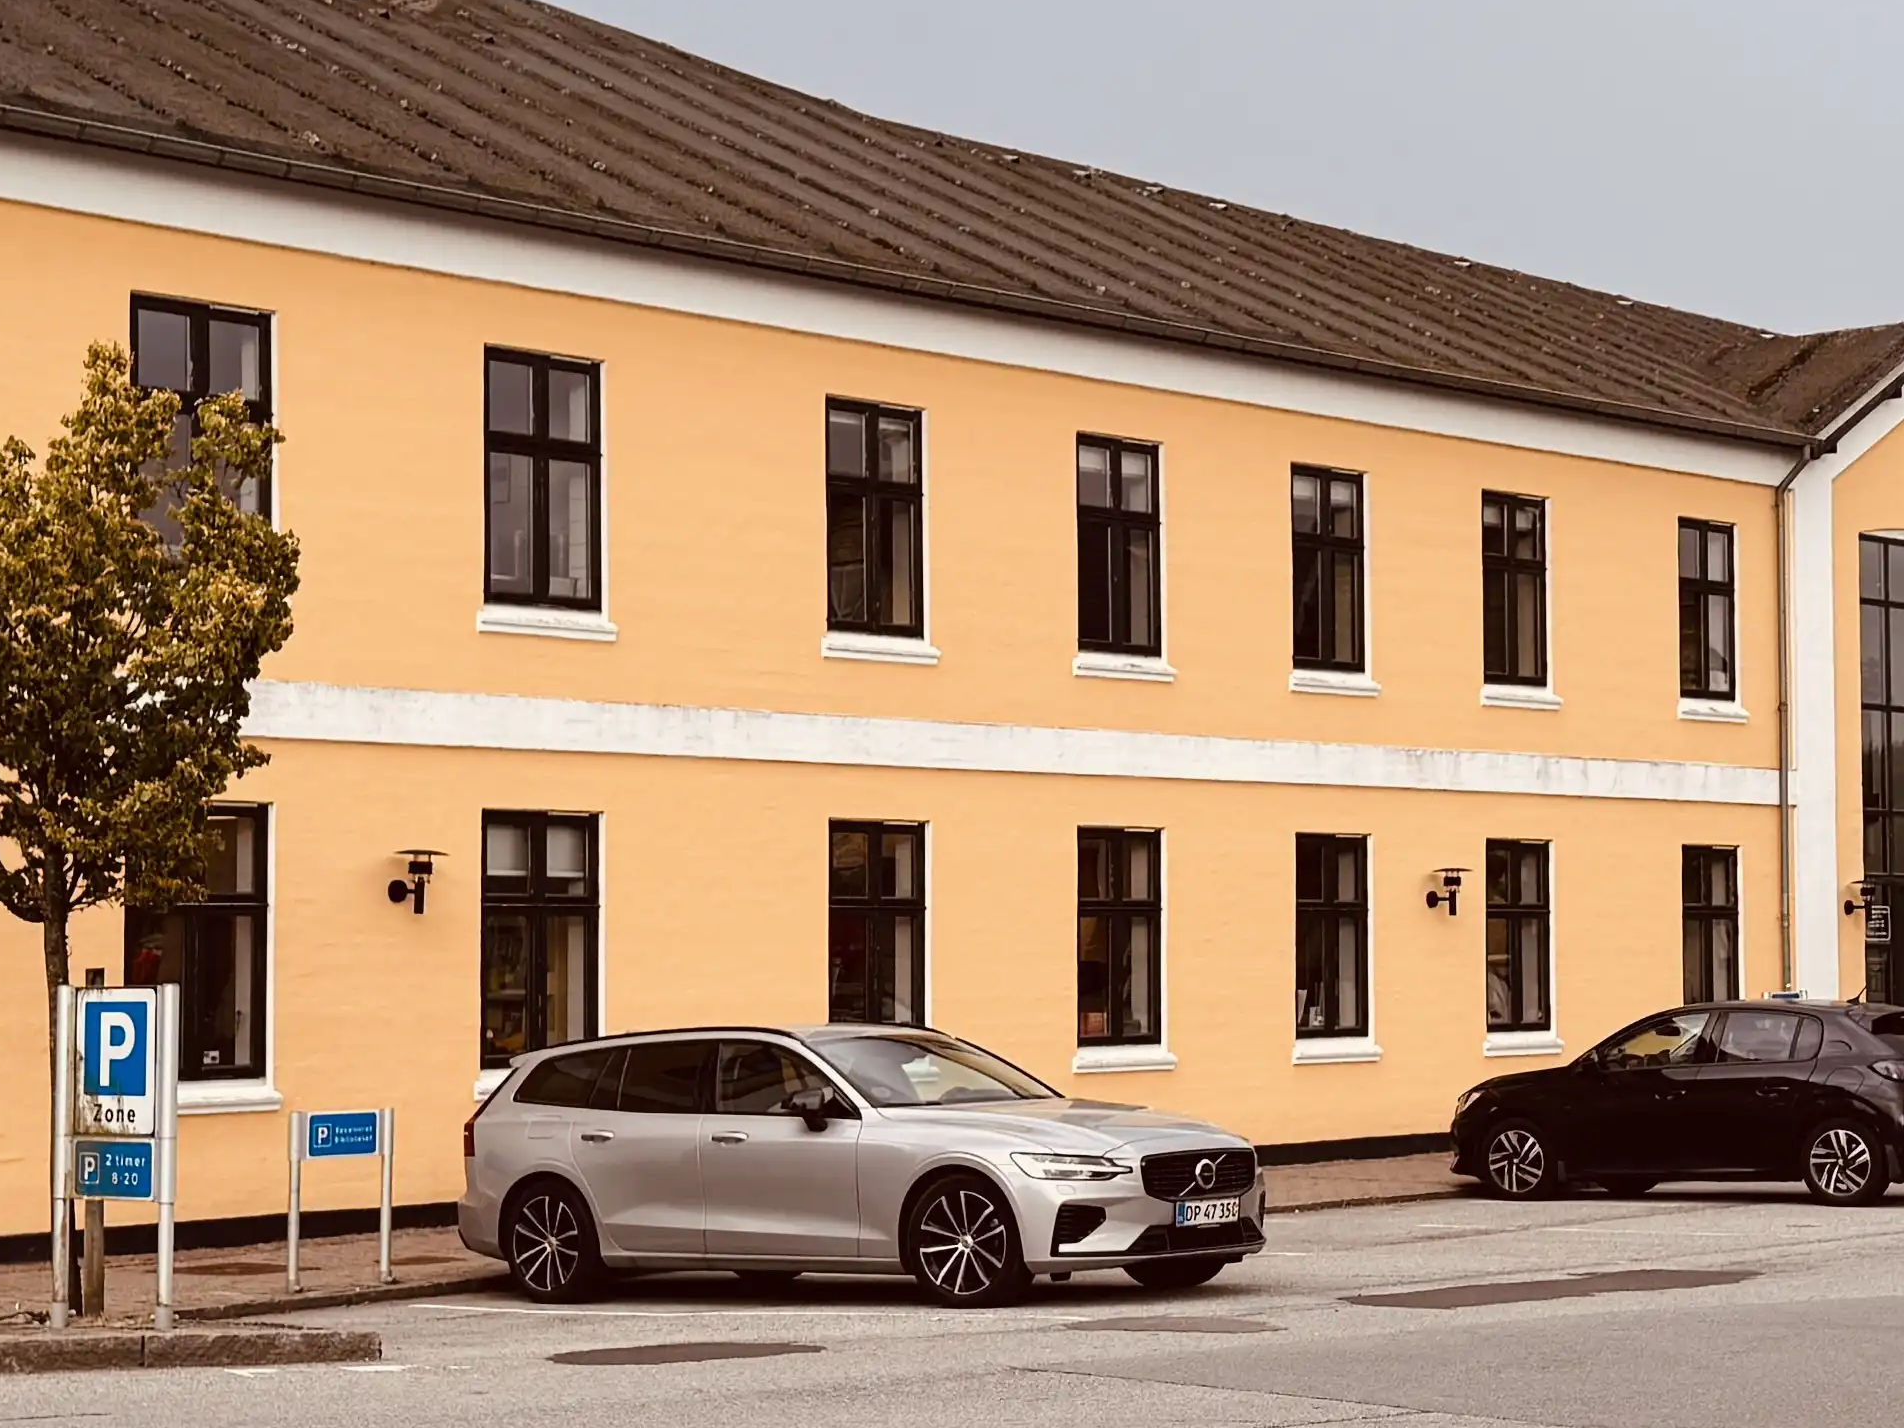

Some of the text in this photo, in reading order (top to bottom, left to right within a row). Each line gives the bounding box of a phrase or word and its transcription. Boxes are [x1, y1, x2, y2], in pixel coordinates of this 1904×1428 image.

[99, 1011, 136, 1087] P
[93, 1103, 136, 1123] Zone
[318, 1127, 328, 1144] P
[83, 1156, 96, 1181] P
[105, 1153, 146, 1168] 2 timer
[1204, 1204, 1217, 1220] 47
